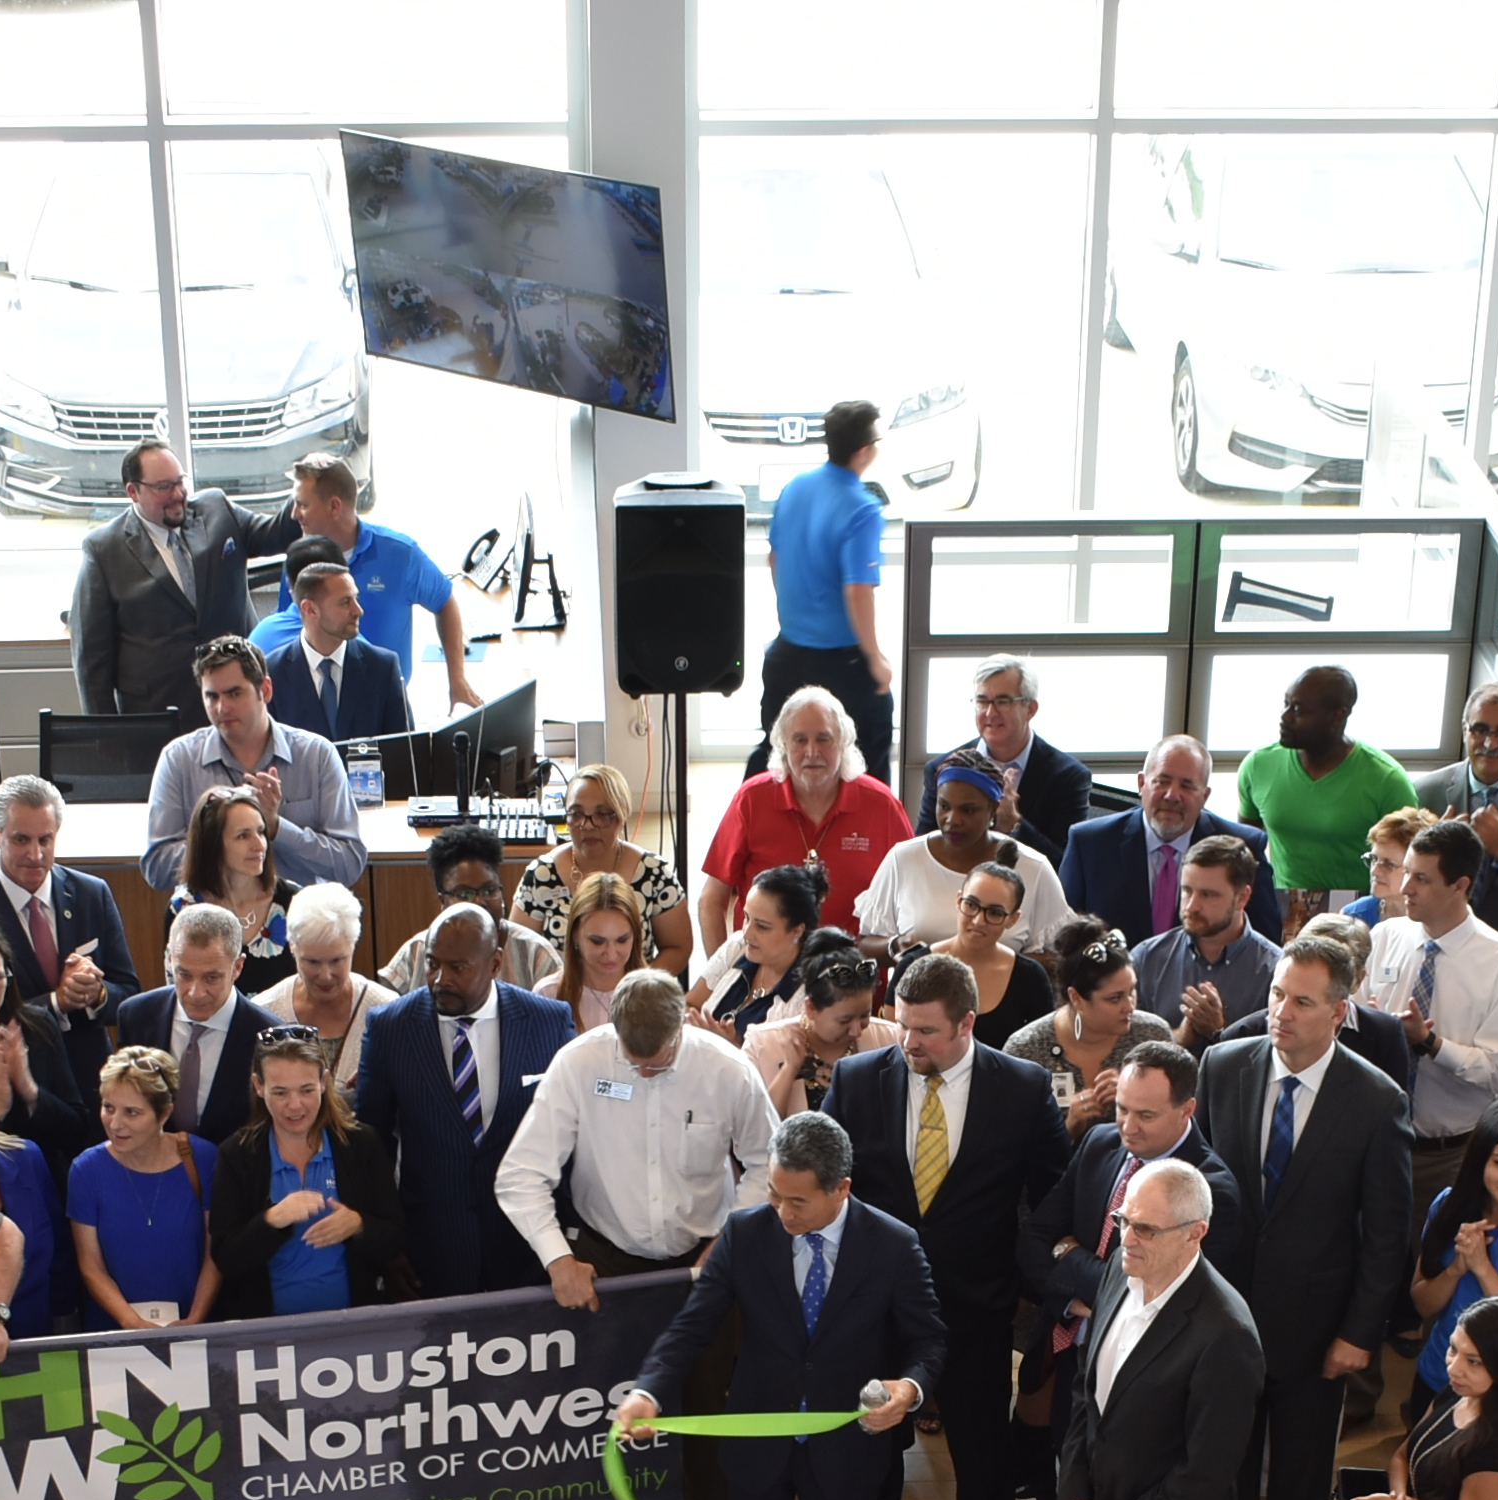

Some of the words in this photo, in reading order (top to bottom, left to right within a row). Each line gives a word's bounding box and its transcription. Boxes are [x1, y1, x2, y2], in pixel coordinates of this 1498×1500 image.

[236, 1329, 576, 1405] Houston
[240, 1380, 638, 1468] Northwes
[241, 1462, 407, 1500] CHAMBER
[418, 1453, 465, 1480] OF
